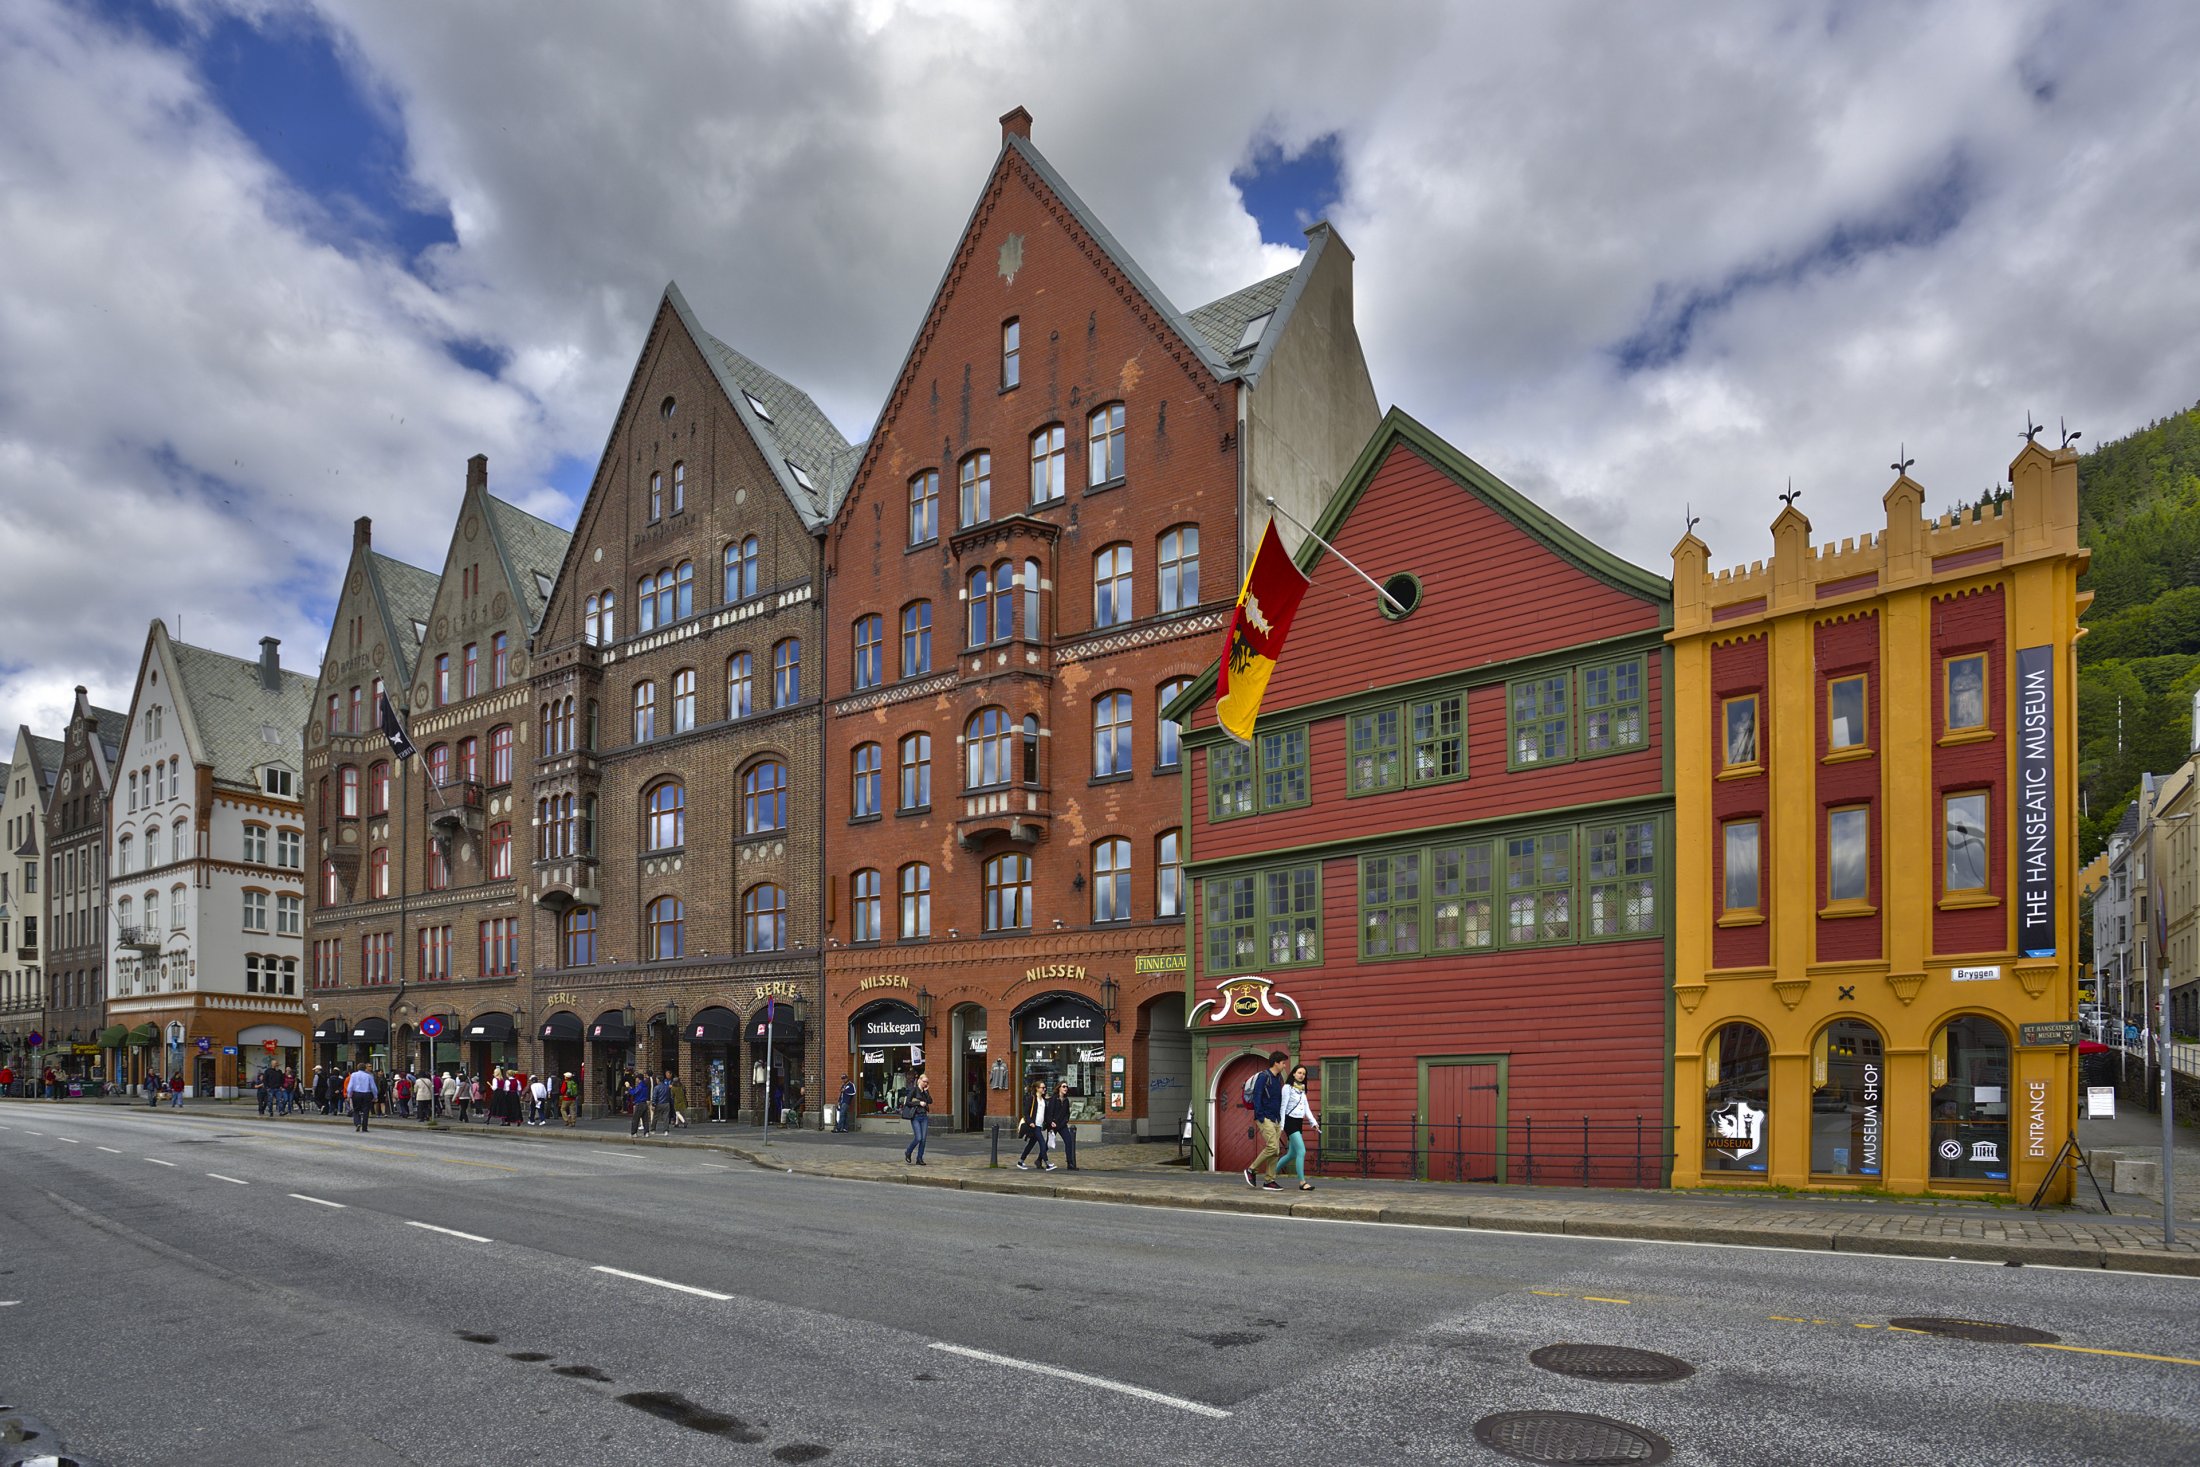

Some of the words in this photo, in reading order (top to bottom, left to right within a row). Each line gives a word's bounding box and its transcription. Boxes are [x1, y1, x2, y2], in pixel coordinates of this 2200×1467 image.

[2025, 669, 2046, 759] MUSEUM
[2025, 767, 2047, 882] HANSEATIC
[2026, 890, 2047, 928] THE
[1026, 964, 1086, 982] NILSSEN
[1957, 969, 1994, 980] Bryggen
[756, 981, 797, 1000] BERLE
[860, 974, 909, 991] NILSSEN
[547, 992, 577, 1007] BERLE
[867, 1022, 920, 1035] Strikkegarn
[1038, 1016, 1092, 1029] Broderier
[1864, 1063, 1878, 1101] SHOP
[2029, 1082, 2045, 1157] ENTRANCE
[1707, 1139, 1752, 1148] MUSEUM
[1863, 1105, 1877, 1165] MUSEUM
